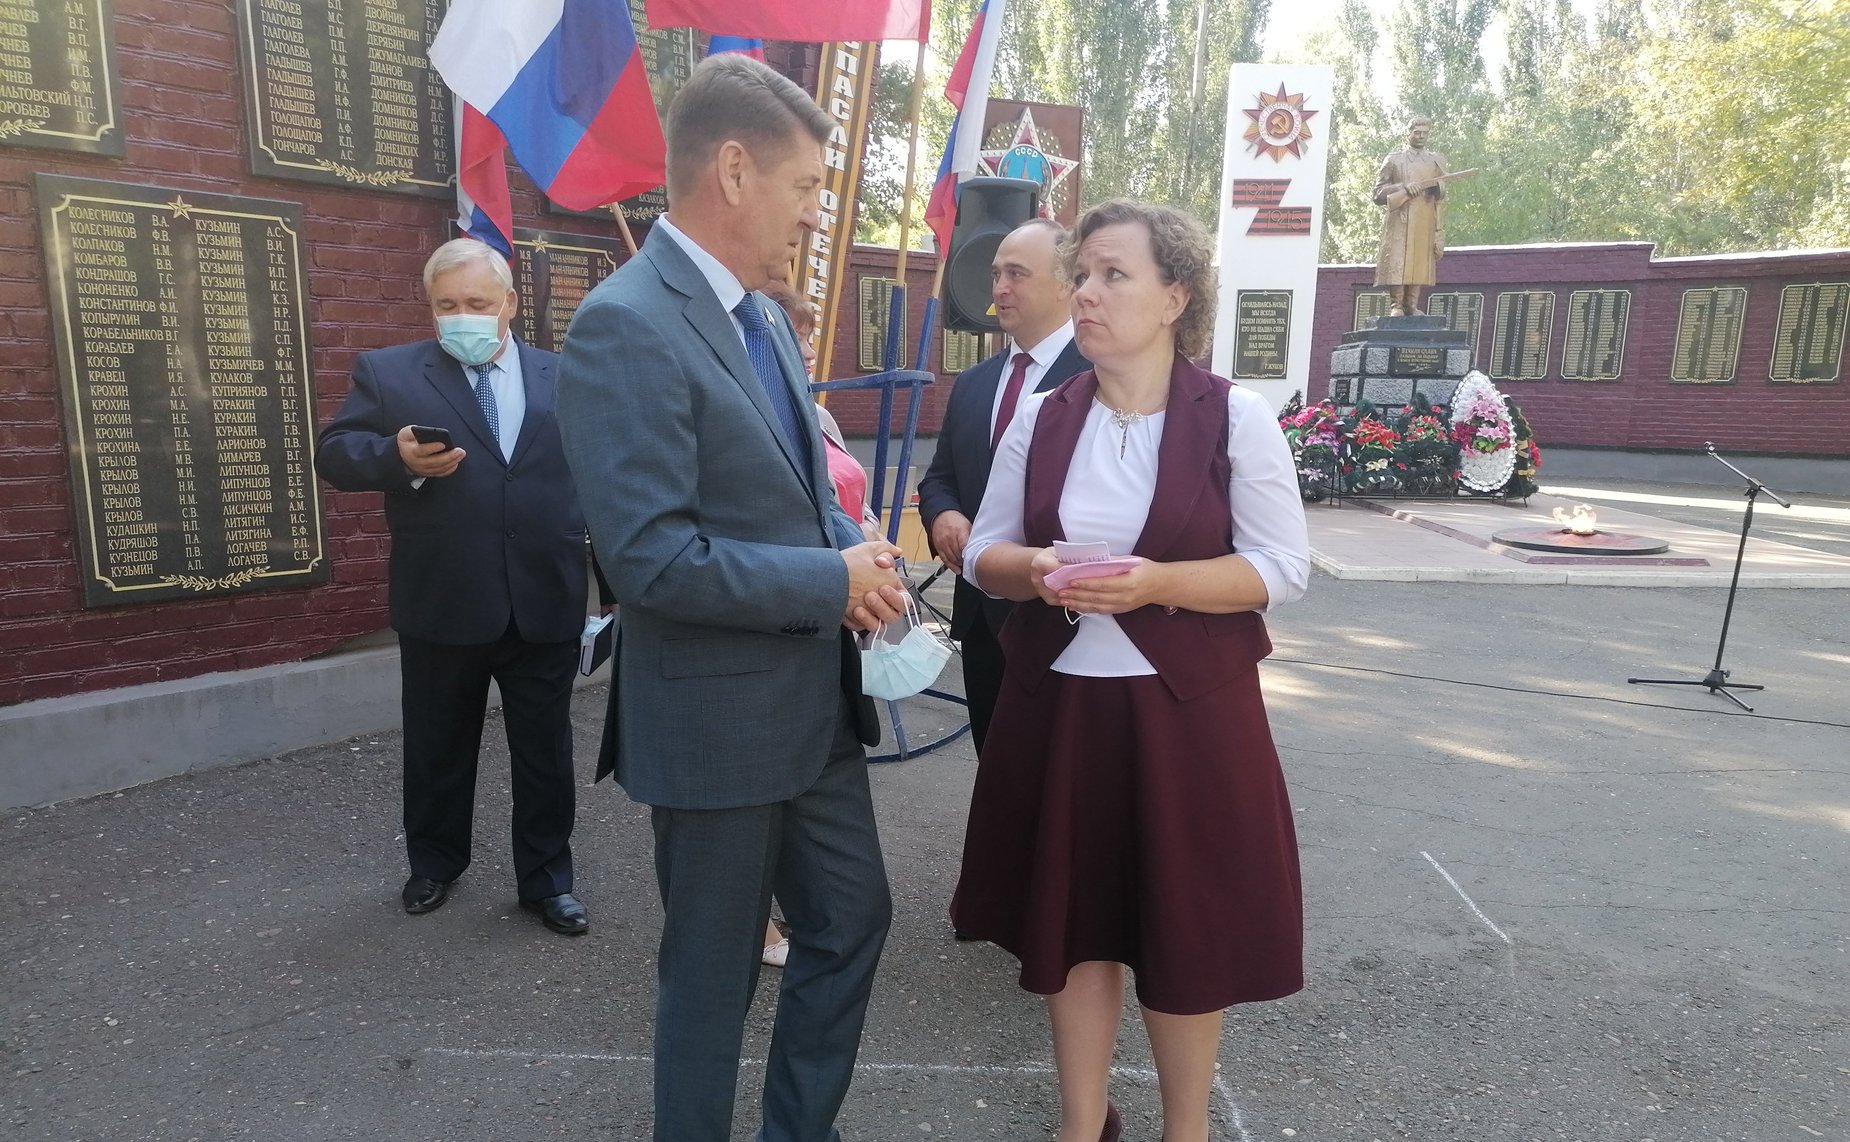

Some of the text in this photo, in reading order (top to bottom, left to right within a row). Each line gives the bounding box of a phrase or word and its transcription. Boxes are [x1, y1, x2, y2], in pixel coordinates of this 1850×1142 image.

[260, 0, 301, 16] ГЛАГОЛЕВ
[364, 6, 405, 25] ДВОЙНИН
[261, 11, 302, 29] ГЛАГОЛЕВ
[262, 25, 304, 43] ГЛАГОЛЕВ
[365, 19, 419, 41] ДЕРЕВЯНКИН
[68, 32, 89, 46] В.П.
[366, 33, 405, 51] ДЕРЯБИН
[264, 40, 310, 59] ГЛАГОЛЕВА
[368, 46, 427, 68] ДЖУМАГАЛИЕВ
[265, 54, 312, 72] ГЛАДЫШЕВ
[368, 60, 403, 77] ДИАНОВ
[266, 68, 313, 86] ГЛАДЫШЕВ
[369, 74, 413, 92] ДМИТРИЕВ
[267, 82, 315, 101] ГЛАДЫШЕВ
[370, 87, 416, 105] ДОМНИКОВ
[268, 96, 316, 115] ГЛАДЫШЕВ
[371, 101, 417, 118] ДОМНИКОВ
[270, 110, 321, 129] ГОЛОЩАПОВ
[372, 114, 418, 133] ДОМНИКОВ
[271, 125, 322, 142] ГОЛОЩАПОВ
[373, 127, 419, 144] ДОМНИКОВ
[272, 138, 315, 156] ГОНЧАРОВ
[374, 141, 418, 158] ДОНЕЦКИХ
[1016, 147, 1038, 158] СССР
[375, 154, 413, 169] ДОНСКАЯ
[1245, 182, 1274, 201] 1941
[67, 205, 135, 223] КОЛЕСНИКОВ
[1267, 210, 1302, 229] 1945
[69, 221, 136, 238] КОЛЕСНИКОВ
[193, 218, 284, 238] КУЗЬМИН А.С.
[72, 237, 124, 252] КОЛПАКОВ
[196, 232, 285, 251] КУЗЬМИН В.И.
[74, 252, 127, 267] КОМБАРОВ
[197, 247, 286, 265] КУЗЬМИН Г.К.
[75, 267, 137, 282] КОНДРАШОВ
[198, 261, 287, 278] КУЗЬМИН И.П.
[77, 281, 138, 296] КОНОНЕНКО
[200, 275, 288, 291] КУЗЬМИН И.С.
[78, 296, 156, 312] КОНСТАНТИНОВ
[202, 289, 289, 305] КУЗЬМИН К.З.
[203, 303, 248, 316] КУЗЬМИН
[80, 311, 140, 325] КОПЫРУЛИН
[204, 317, 291, 331] КУЗЬМИН П.Д.
[82, 326, 164, 340] КОРАБЕЛЬНИКОВ
[206, 331, 292, 344] КУЗЬМИН С.П.
[84, 340, 134, 353] КОРАБЛЕВ
[207, 344, 294, 358] КУЗЬМИН Ф.Г.
[86, 355, 120, 367] КОСОВ
[208, 358, 295, 371] КУЗЬМИЧЕВ М.М.
[88, 369, 126, 382] КРАВЕЦ
[209, 371, 296, 383] КУЛАКОВ А.И.
[89, 384, 128, 396] КРОХИН
[210, 385, 297, 397] КУПРИЯНОВ Г.П.
[91, 398, 130, 410] КРОХИН
[212, 399, 298, 410] КУРАКИН В.Г.
[93, 412, 131, 424] КРОХИН
[213, 412, 299, 423] КУРАКИН В.Г.
[94, 427, 133, 438] КРОХИН
[214, 425, 300, 436] КУРАКИН Г.В.
[96, 441, 140, 452] КРОХИНА
[216, 437, 301, 450] ЛАРИОНОВ П.В.
[97, 454, 136, 467] КРЫЛОВ
[217, 450, 302, 463] ЛИМАРЕВ В.Г.
[99, 468, 138, 481] КРЫЛОВ
[219, 463, 303, 476] ЛИПУНЦОВ В.Е.
[101, 482, 141, 495] КРЫЛОВ
[220, 475, 304, 489] ЛИПУНЦОВ Е.Е.
[102, 495, 141, 509] КРЫЛОВ
[221, 488, 305, 502] ЛИПУНЦОВ Ф.Е.
[222, 500, 306, 515] ЛИСИЧКИН А.М.
[104, 509, 143, 522] КРЫЛОВ
[224, 513, 307, 528] ЛИТЯГИН И.С.
[106, 522, 157, 536] КУДАШКИН
[225, 525, 308, 541] ЛИТЯГИНА Е.Ф.
[107, 535, 158, 550] КУДРЯШОВ
[226, 537, 309, 554] ЛОГАЧЕВ Р.П.
[108, 548, 159, 563] КУЗНЕЦОВ
[227, 550, 310, 566] ЛОГАЧЕВ С.В.
[110, 562, 153, 577] КУЗЬМИН
